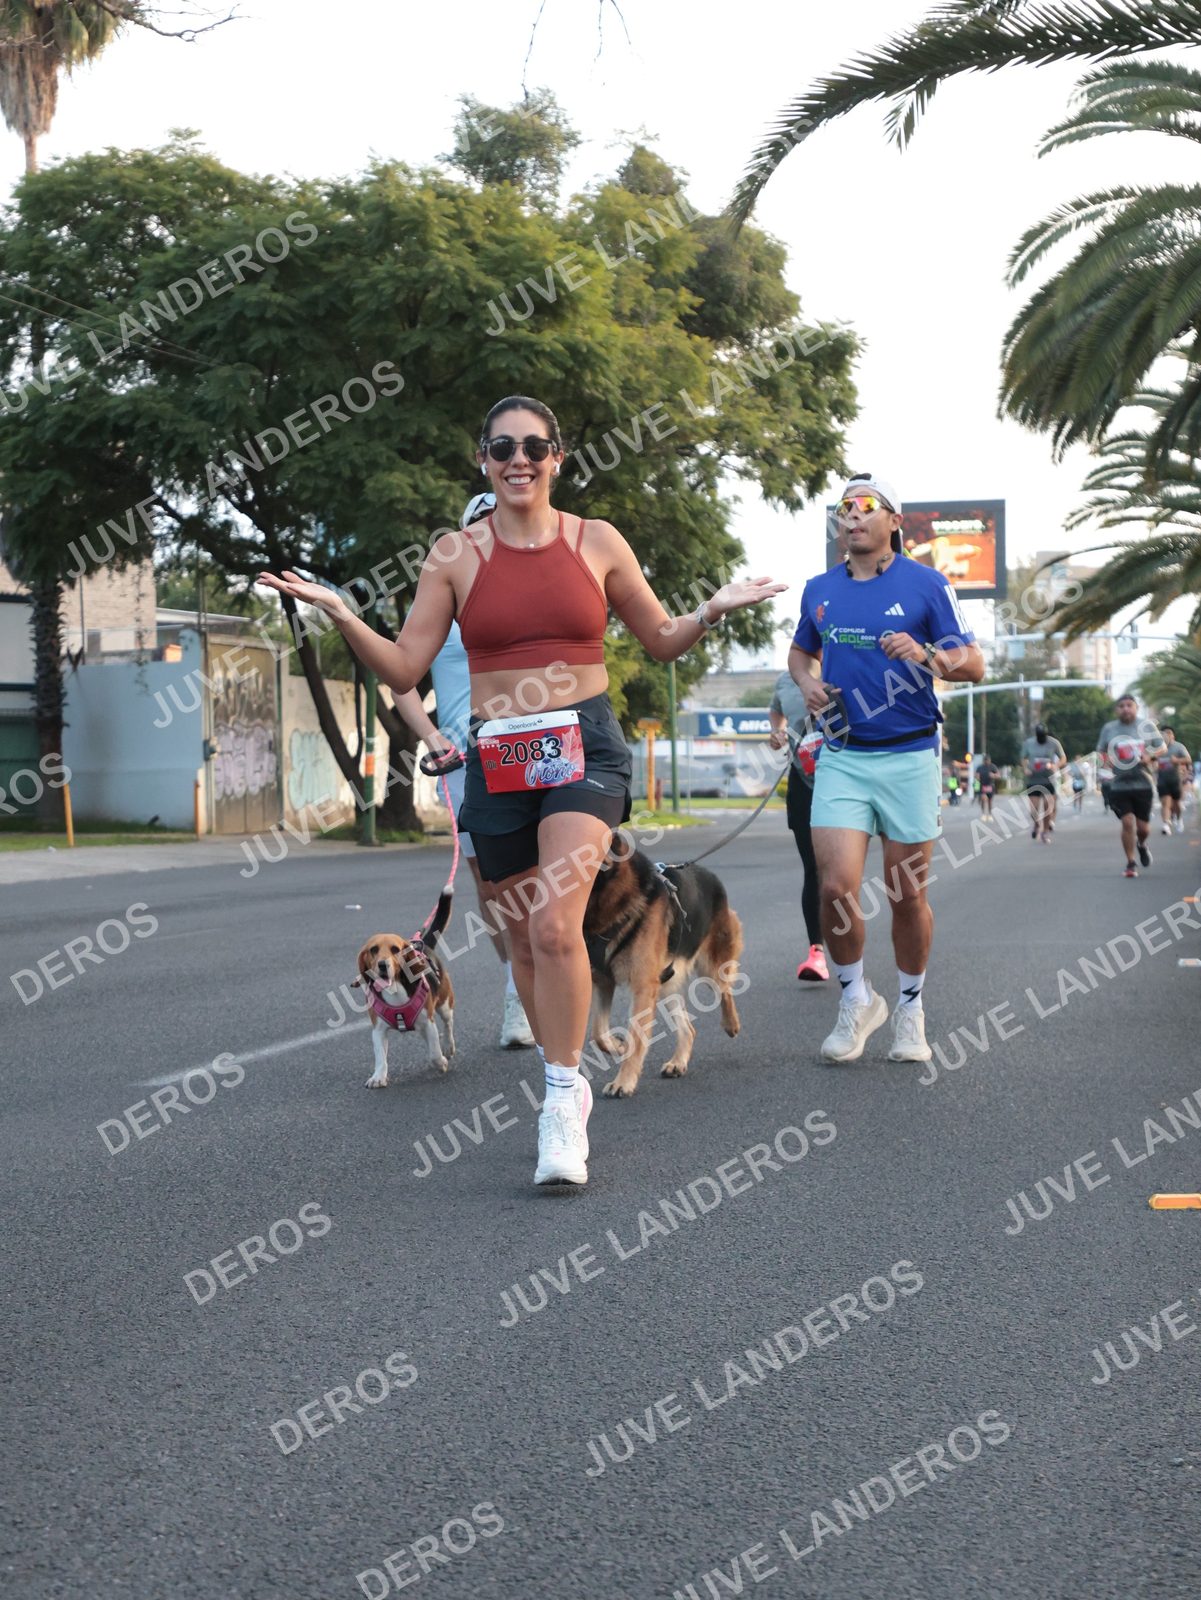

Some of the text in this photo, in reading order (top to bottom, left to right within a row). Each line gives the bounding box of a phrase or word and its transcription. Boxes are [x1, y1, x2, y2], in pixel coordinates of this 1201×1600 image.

[839, 633, 861, 643] GDL
[508, 721, 538, 731] Openbank
[499, 736, 562, 767] 2083
